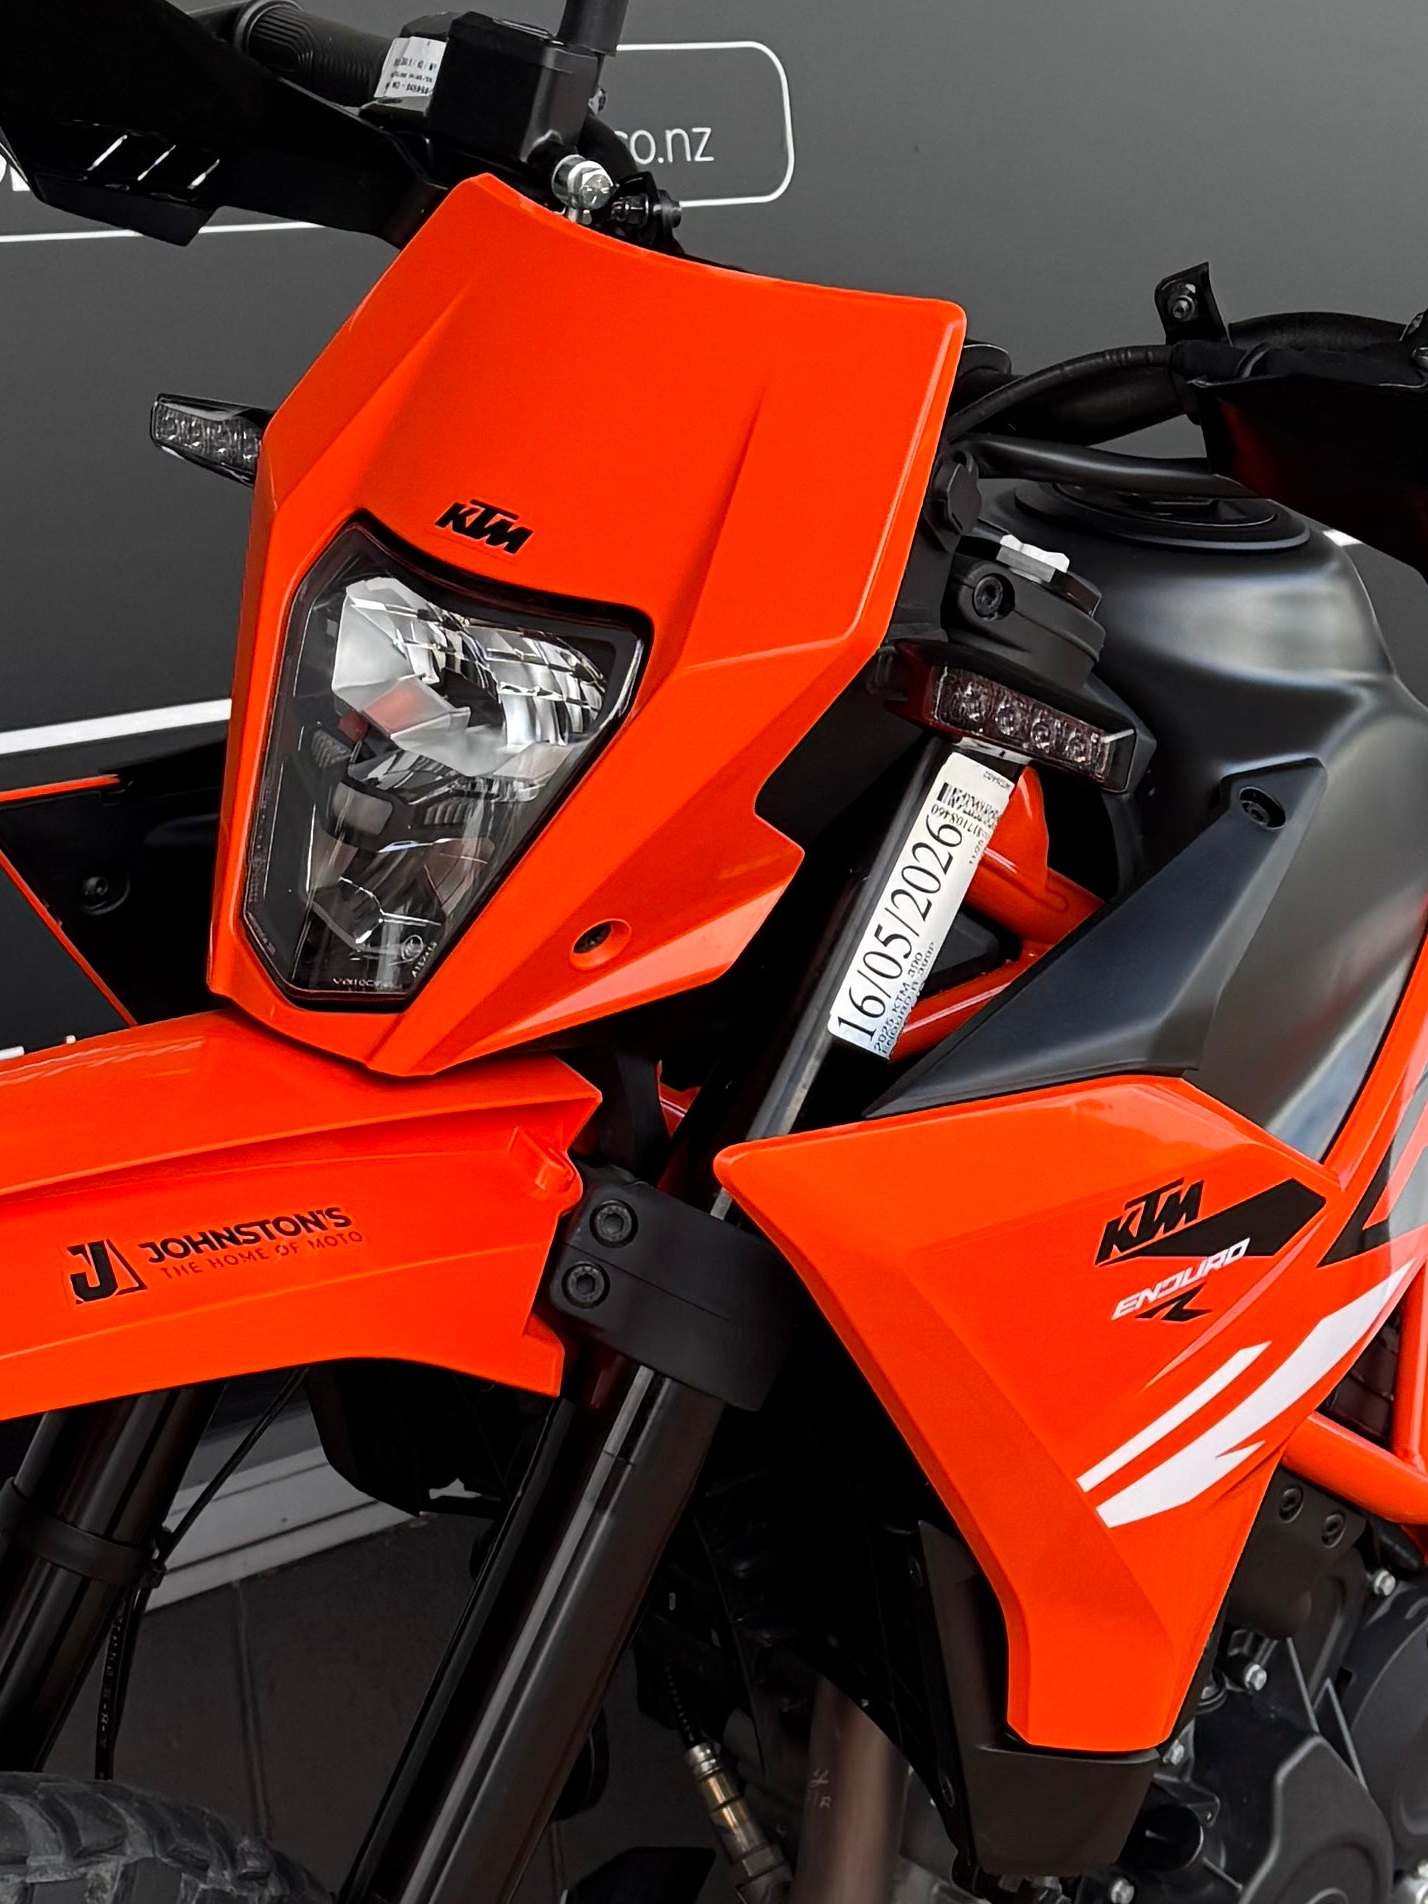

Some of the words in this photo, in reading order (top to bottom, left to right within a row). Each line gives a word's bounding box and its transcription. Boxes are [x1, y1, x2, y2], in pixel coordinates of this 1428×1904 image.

[434, 498, 534, 555] KTM
[837, 812, 964, 1043] 16/05/2026
[138, 1206, 353, 1264] JOHNSTON'S
[160, 1259, 203, 1280] THE
[209, 1246, 270, 1270] HOME
[275, 1241, 299, 1258] OF
[311, 1230, 364, 1251] MOTO
[1094, 1177, 1204, 1266] KTM
[1110, 1237, 1252, 1320] ENDURO
